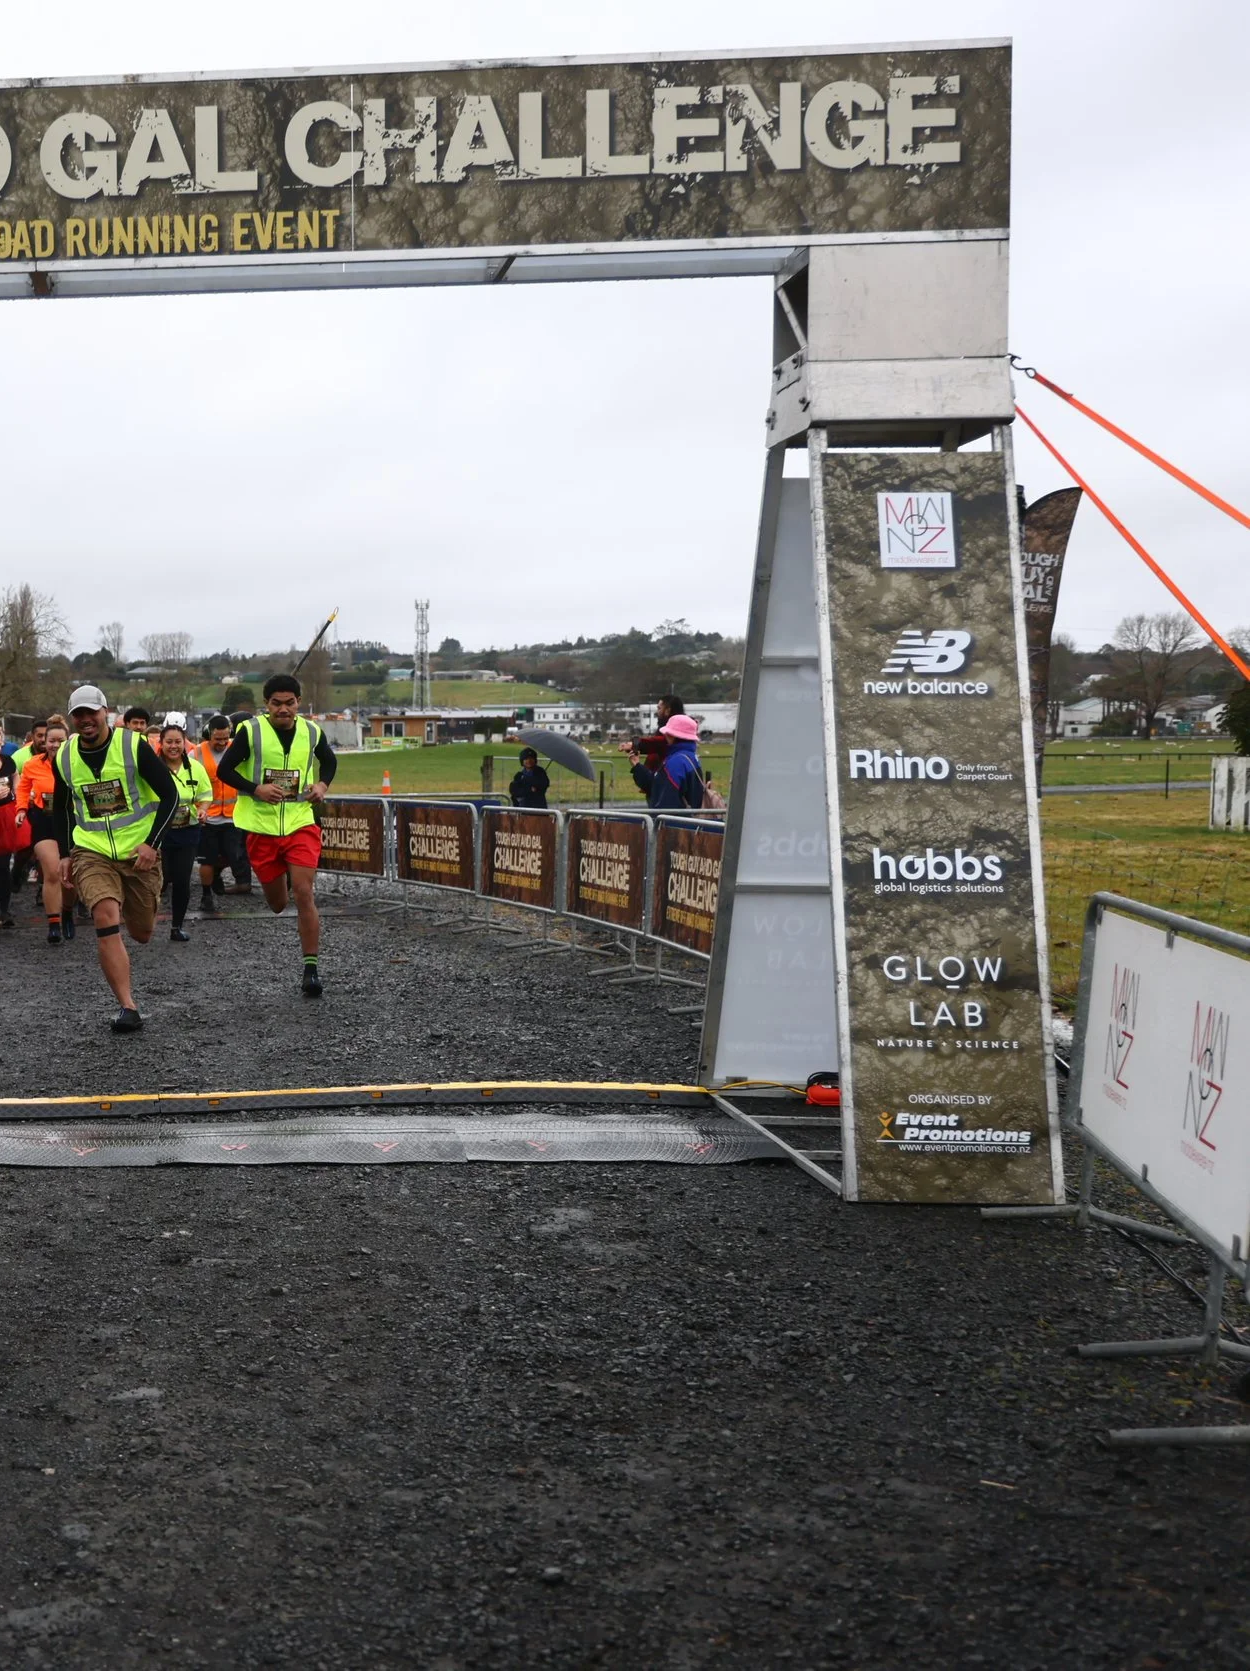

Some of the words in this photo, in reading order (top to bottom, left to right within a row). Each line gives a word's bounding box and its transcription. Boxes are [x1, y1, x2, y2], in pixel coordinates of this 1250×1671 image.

[39, 104, 258, 199] GAL
[284, 73, 961, 188] CHALLENGE
[66, 215, 218, 257] RUNNING
[233, 209, 341, 251] EVENT
[1020, 552, 1060, 566] OUGH
[1020, 566, 1051, 583] UY
[1022, 584, 1049, 602] AL
[863, 680, 902, 695] new
[907, 678, 989, 695] balance
[849, 749, 950, 780] Rhino
[955, 763, 975, 773] Only
[977, 763, 998, 772] from
[956, 772, 987, 782] Carpet
[988, 772, 1013, 781] Court
[320, 829, 370, 850] CHALLENGE
[409, 836, 460, 861] CHALLENGE
[494, 846, 542, 875] CHALLENGE
[872, 848, 1002, 881] hobbs
[580, 857, 630, 891] CHALLENGE
[668, 872, 718, 914] CHALLENG
[874, 882, 907, 895] global
[909, 882, 952, 895] logistics
[955, 883, 1004, 893] solutions
[883, 955, 1003, 989] GLOW
[909, 1001, 984, 1027] LAB
[876, 1039, 934, 1048] NATURE
[955, 1039, 1020, 1049] SCIENCE
[908, 1094, 976, 1104] ORGANISED
[978, 1095, 992, 1105] BY
[895, 1111, 959, 1127] Event
[903, 1127, 1031, 1143] Promotions
[898, 1143, 1031, 1154] www.eventpromotions.co.nz
